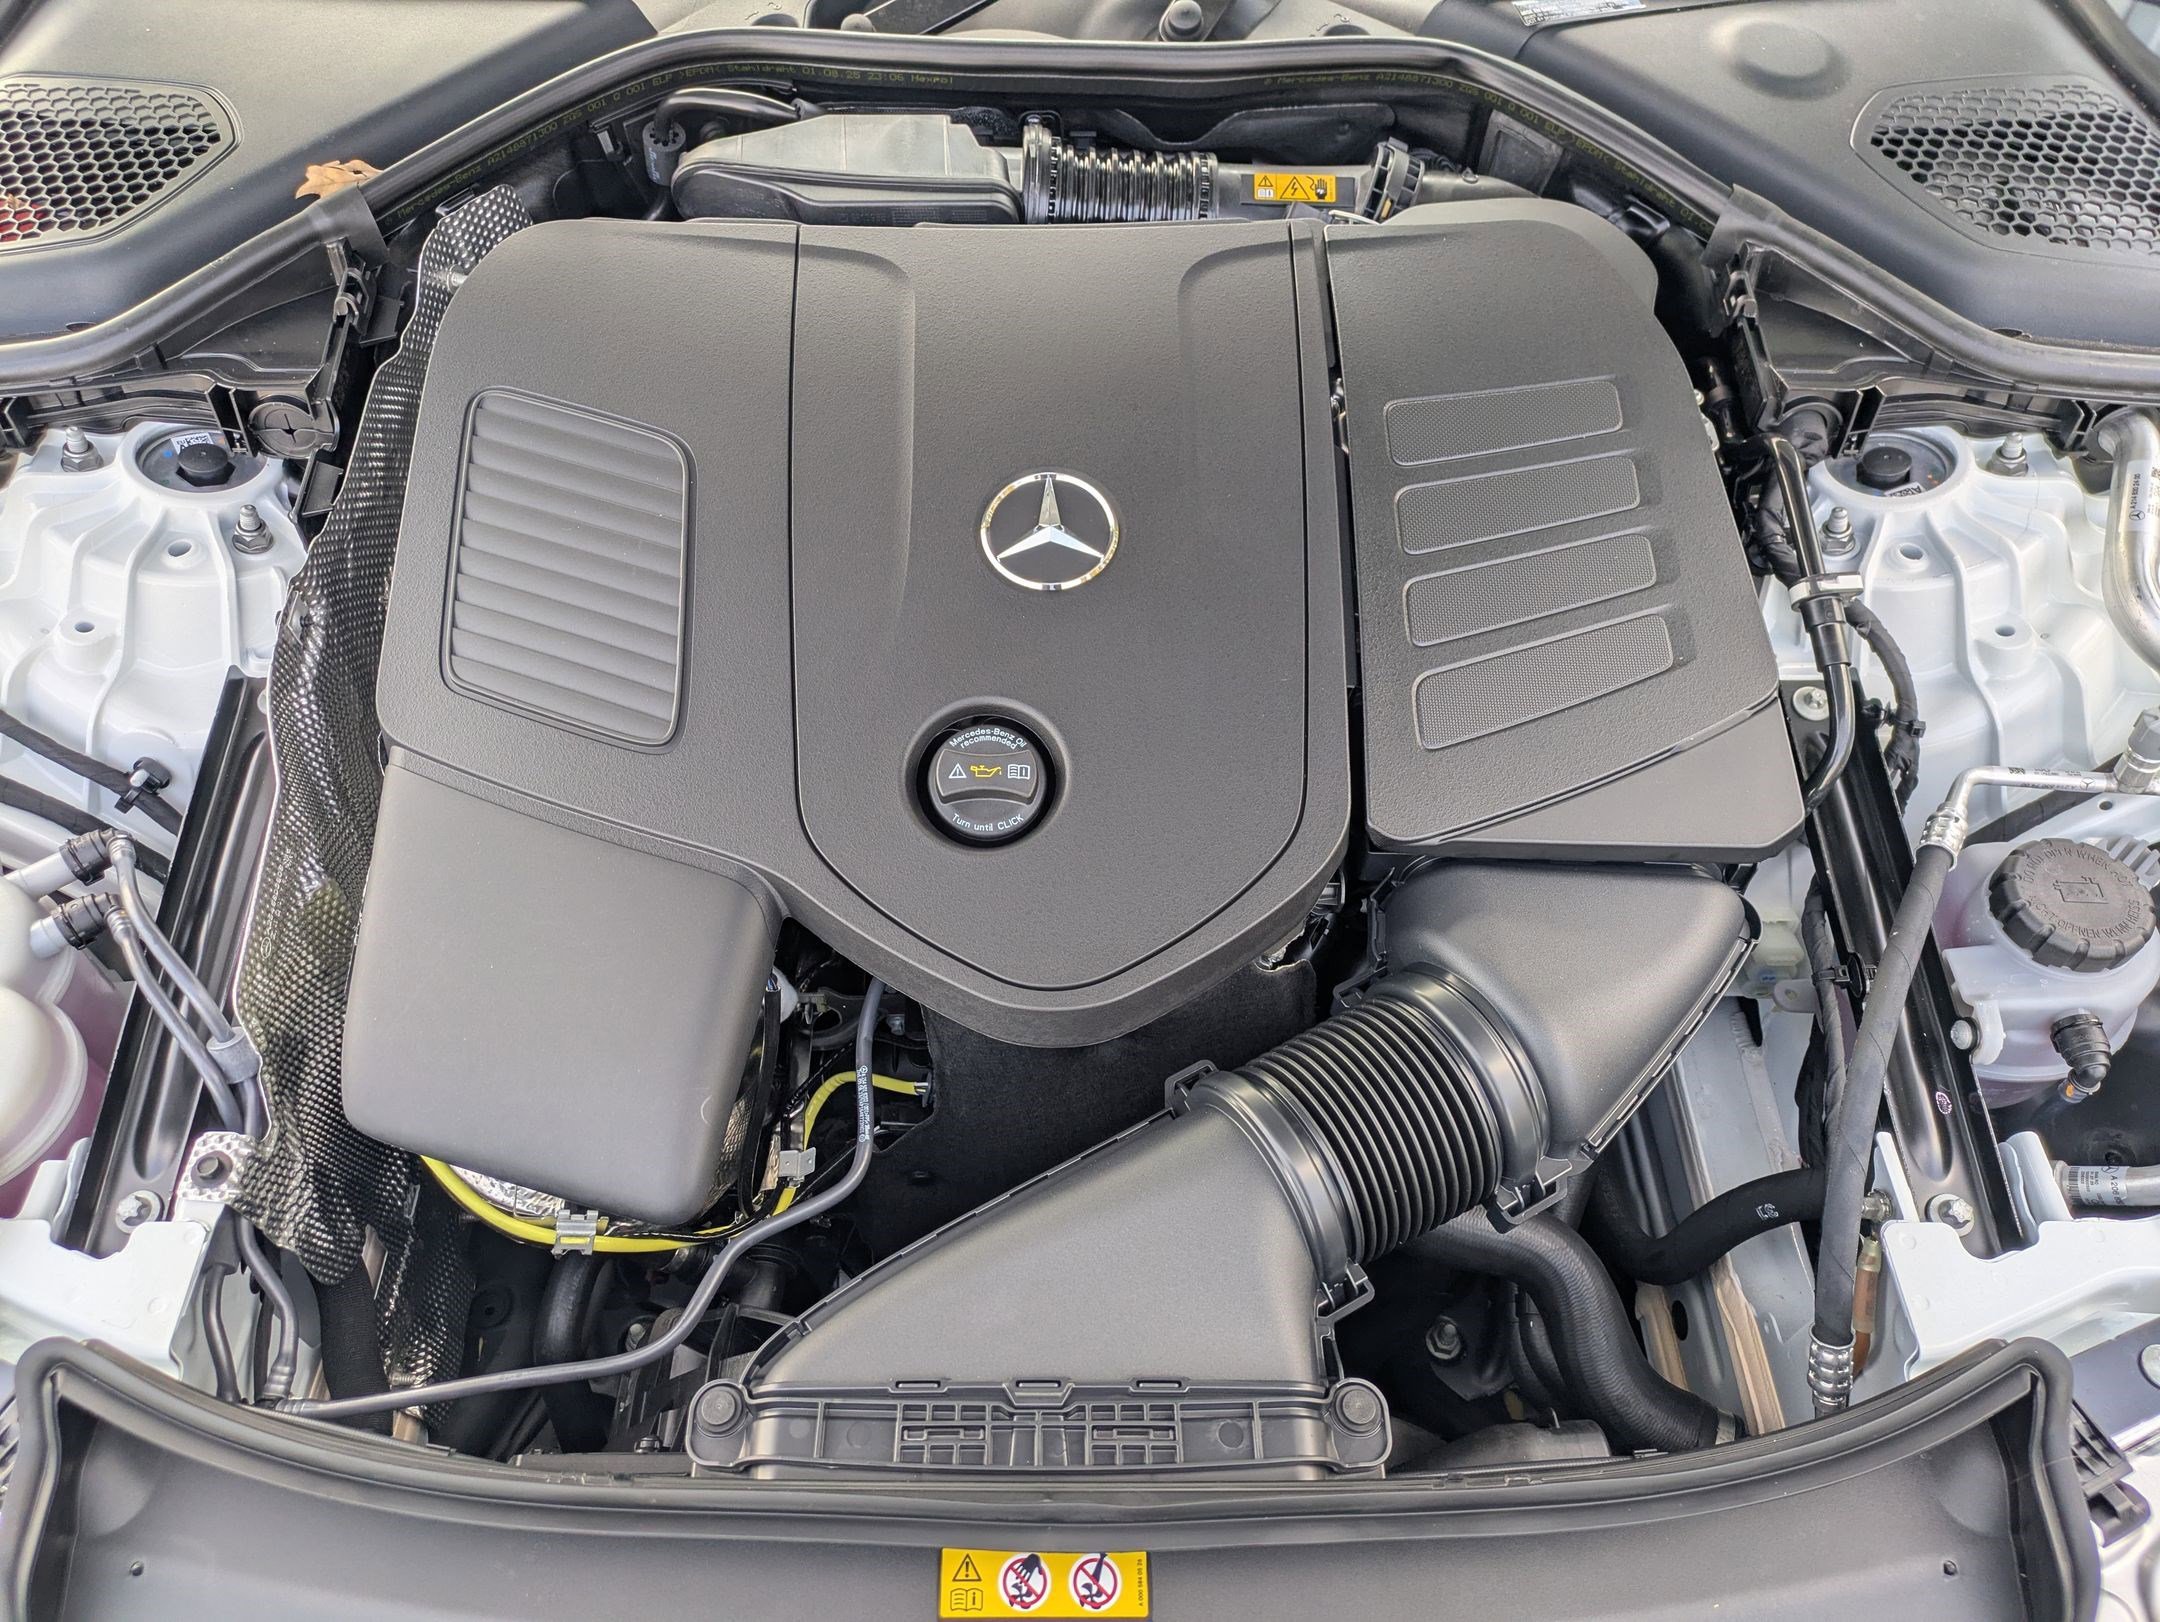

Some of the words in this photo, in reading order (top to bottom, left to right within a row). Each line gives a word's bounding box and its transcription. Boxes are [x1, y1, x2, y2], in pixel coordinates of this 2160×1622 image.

[949, 727, 1015, 748] Mercedes-Benz
[1016, 737, 1027, 748] Oil
[960, 735, 1017, 750] recommended
[952, 813, 971, 828] Turn
[974, 823, 994, 831] until
[997, 814, 1025, 830] CLICK
[2076, 849, 2110, 870] WHEN
